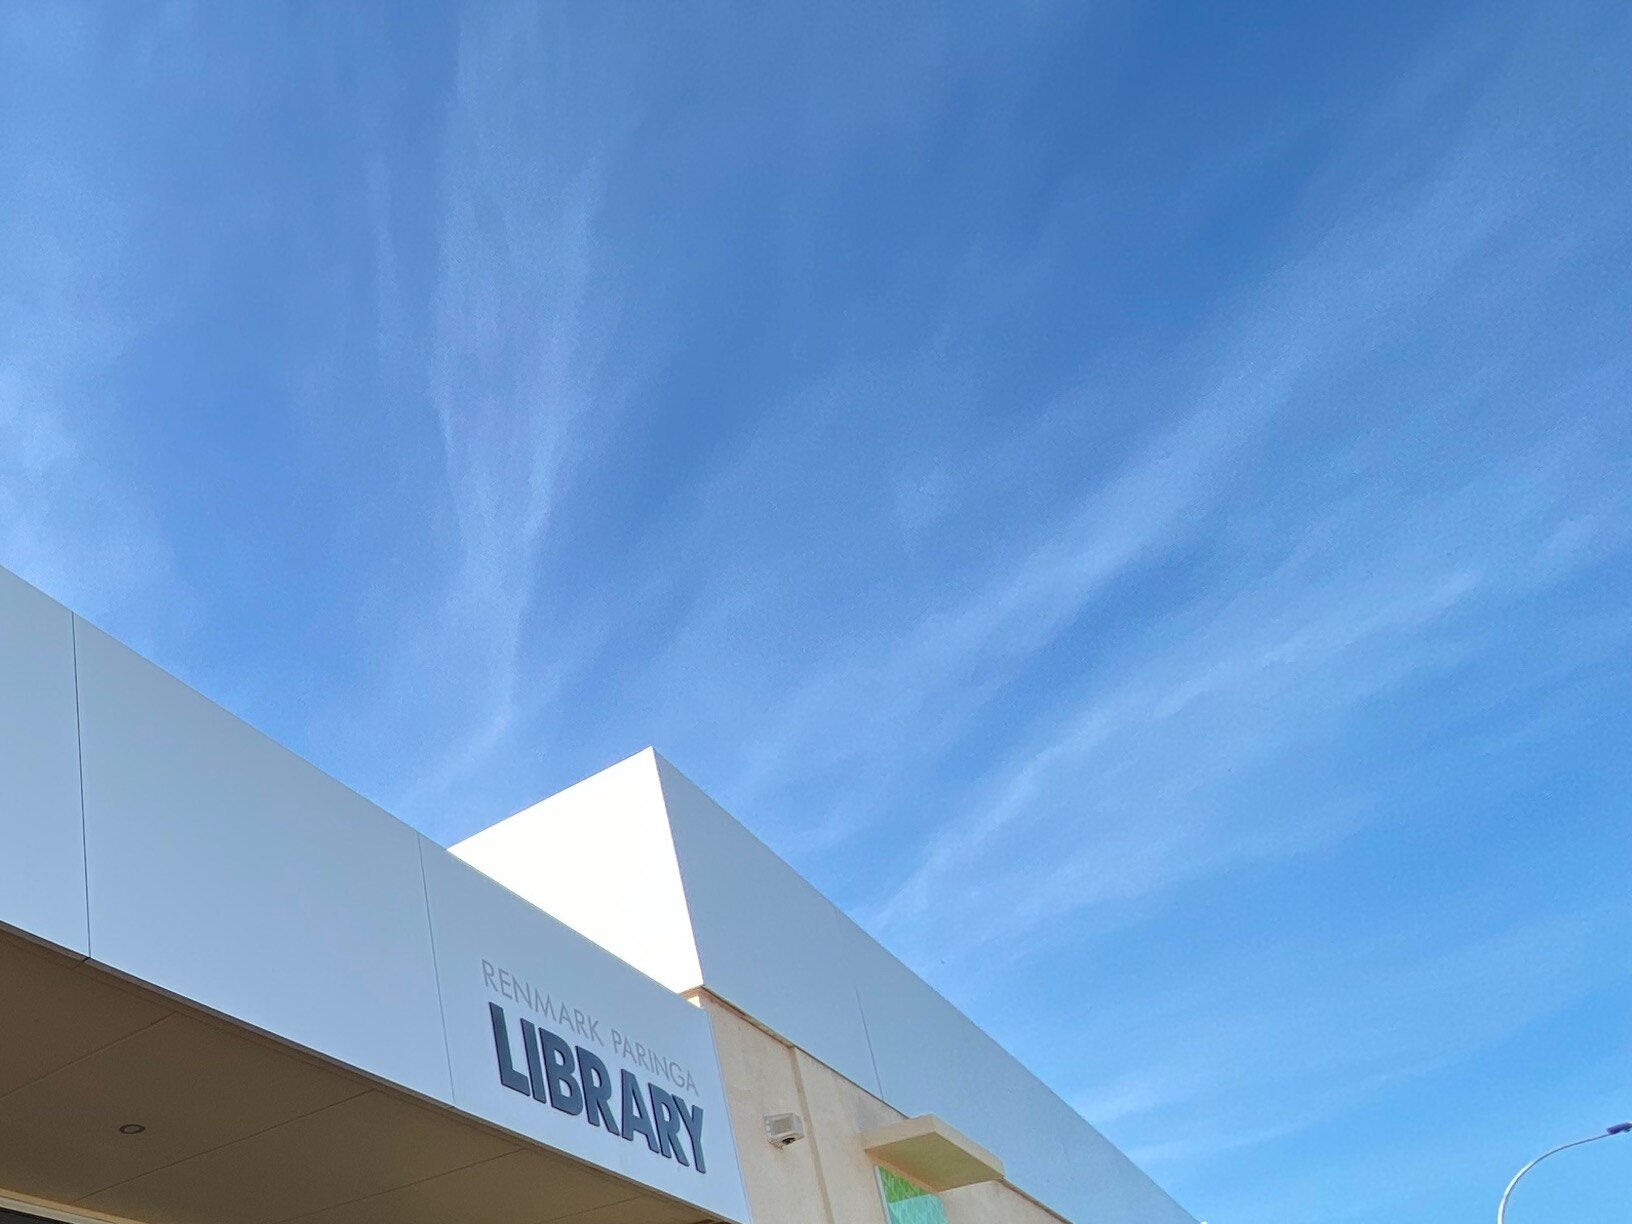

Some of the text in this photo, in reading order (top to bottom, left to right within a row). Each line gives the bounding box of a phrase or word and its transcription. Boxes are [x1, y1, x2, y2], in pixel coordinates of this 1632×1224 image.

[481, 958, 701, 1097] RENMARK PARINGA
[488, 1001, 707, 1174] LIBRARY
